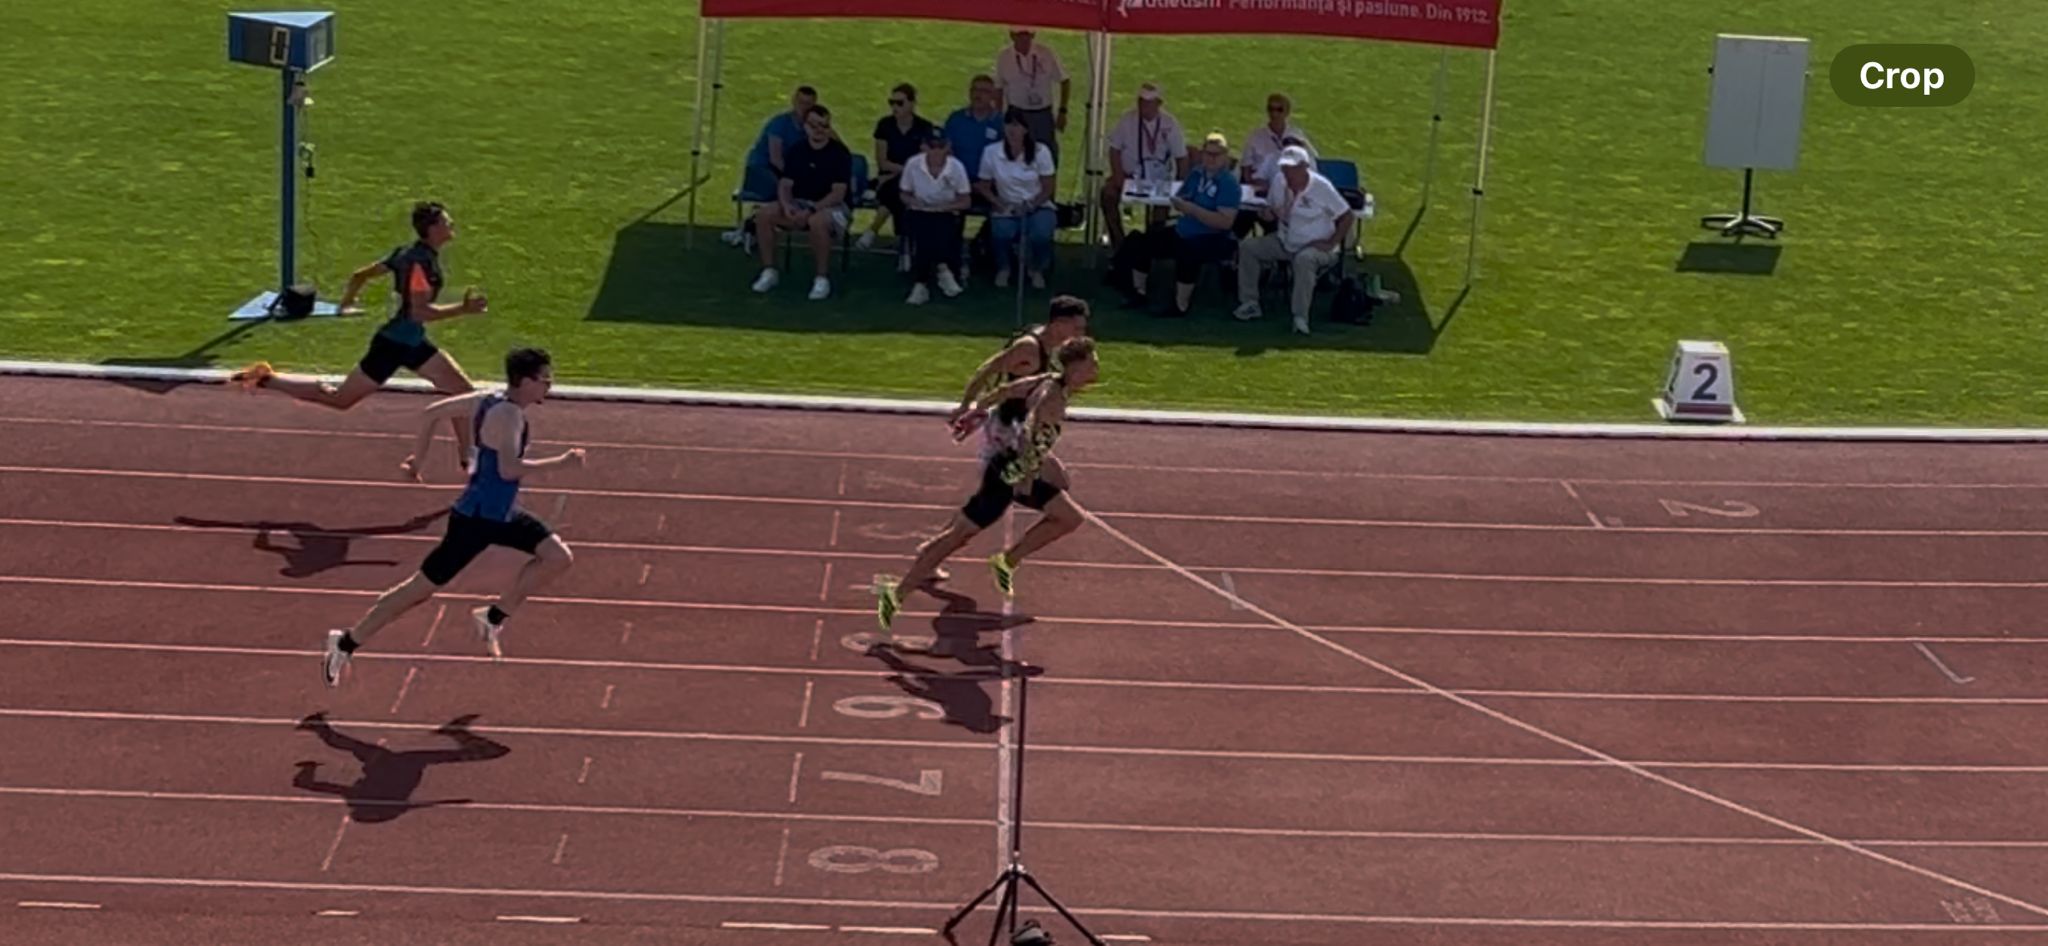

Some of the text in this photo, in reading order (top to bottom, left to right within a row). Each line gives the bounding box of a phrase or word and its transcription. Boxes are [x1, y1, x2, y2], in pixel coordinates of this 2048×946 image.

[1425, 3, 1453, 22] Din
[1691, 363, 1718, 401] 2
[1658, 497, 1761, 518] 2
[832, 695, 946, 719] 6
[821, 769, 943, 796] 7
[807, 845, 939, 873] 8
